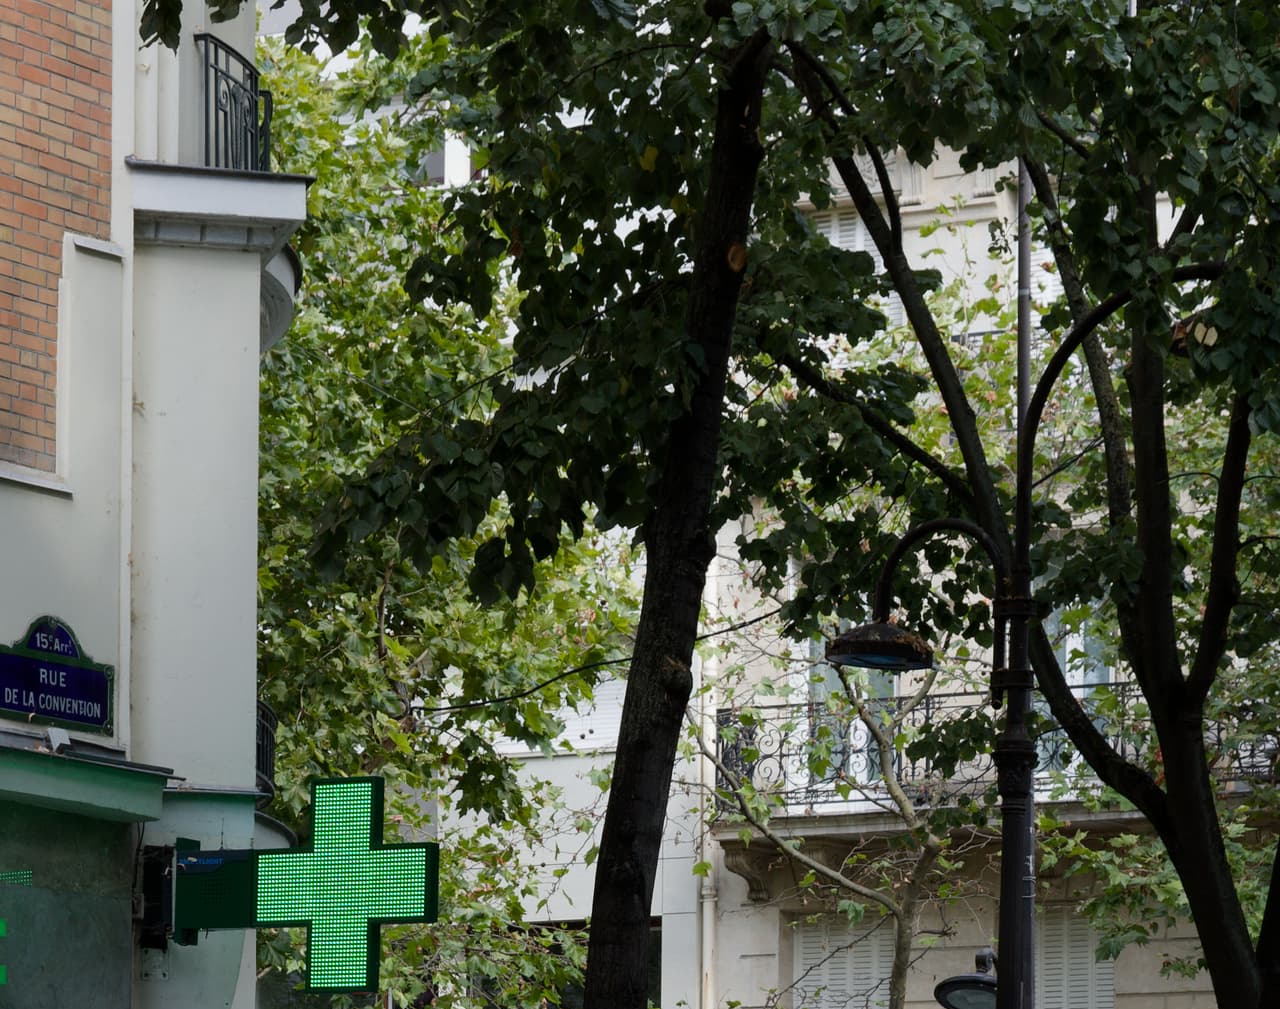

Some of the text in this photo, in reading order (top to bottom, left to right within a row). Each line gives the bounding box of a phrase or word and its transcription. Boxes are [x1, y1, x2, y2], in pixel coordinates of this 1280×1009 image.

[39, 668, 67, 687] RUE
[4, 687, 101, 719] DE LA CONVENTION
